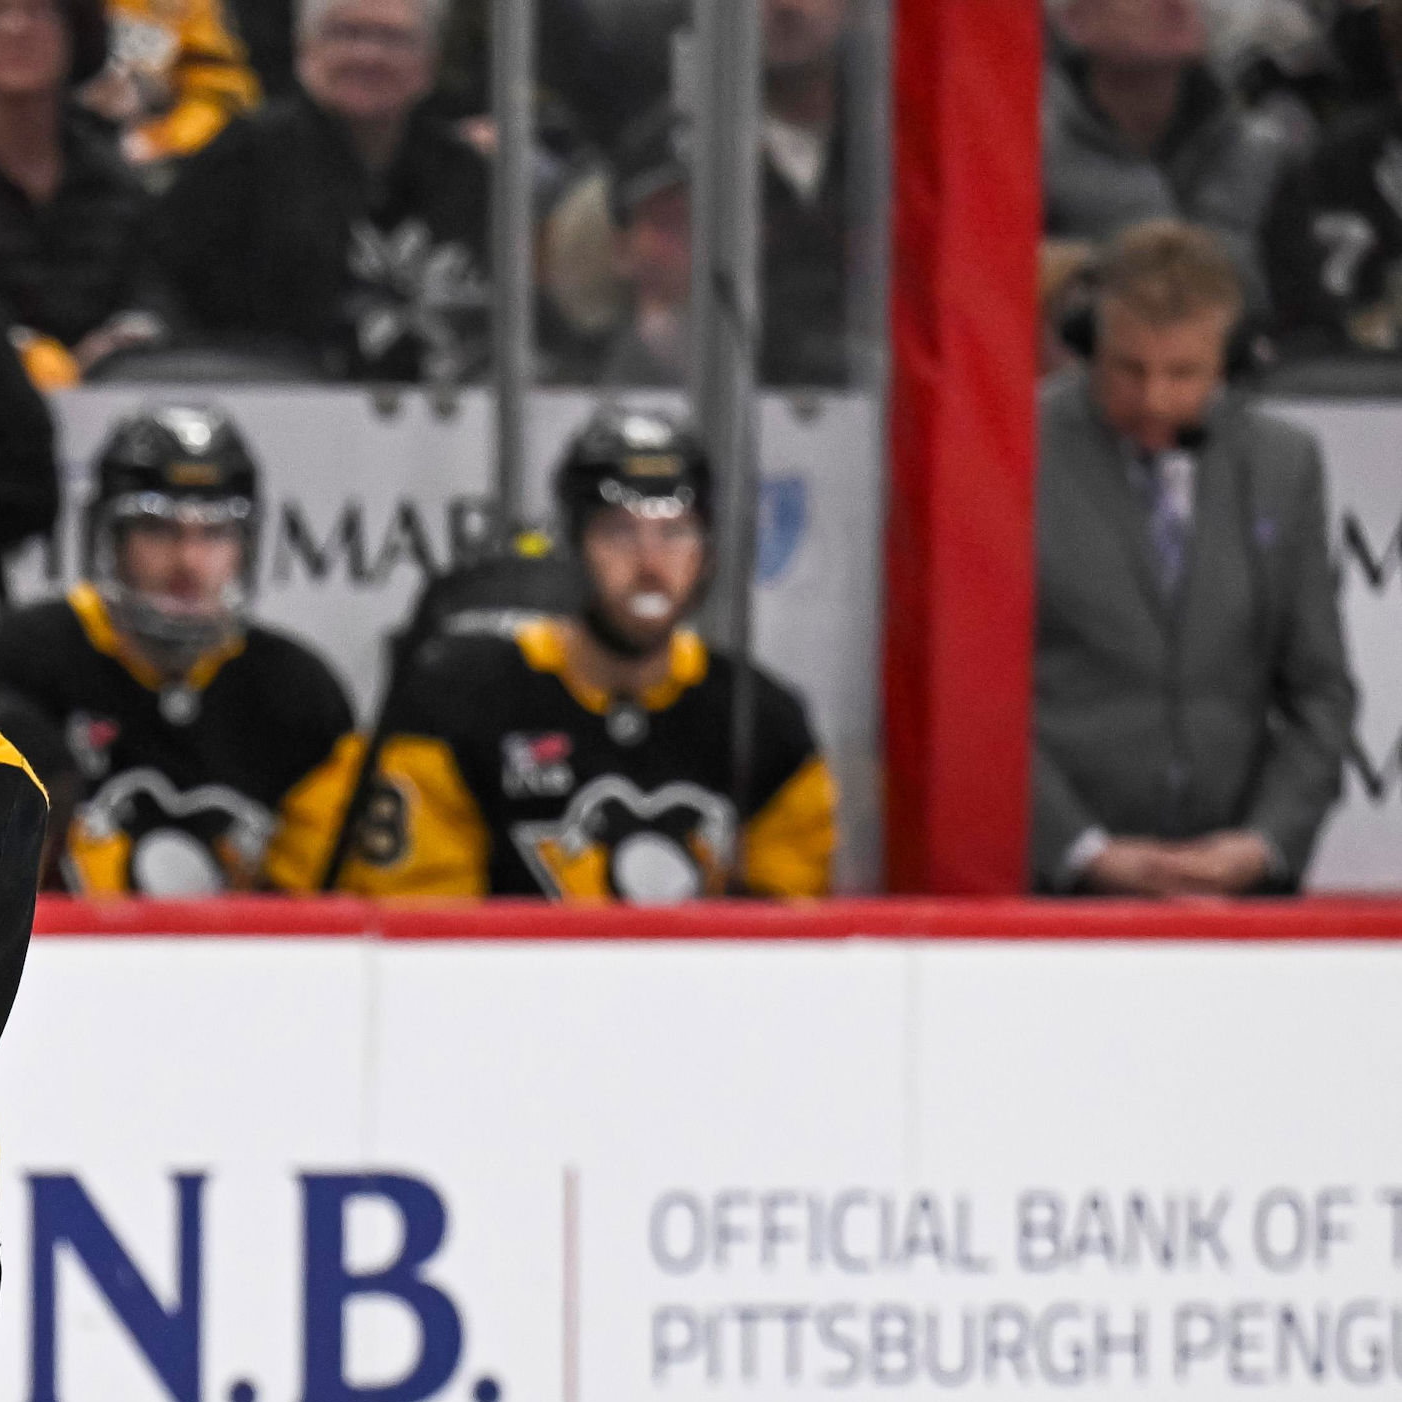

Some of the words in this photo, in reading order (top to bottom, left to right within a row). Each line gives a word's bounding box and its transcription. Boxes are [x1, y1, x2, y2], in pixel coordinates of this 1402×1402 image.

[648, 1186, 995, 1277] OFFICIAL
[1014, 1186, 1232, 1275] BANK
[1252, 1184, 1358, 1275] OF
[649, 1302, 1151, 1388] PITTSBURGH
[1172, 1296, 1402, 1388] PENG
